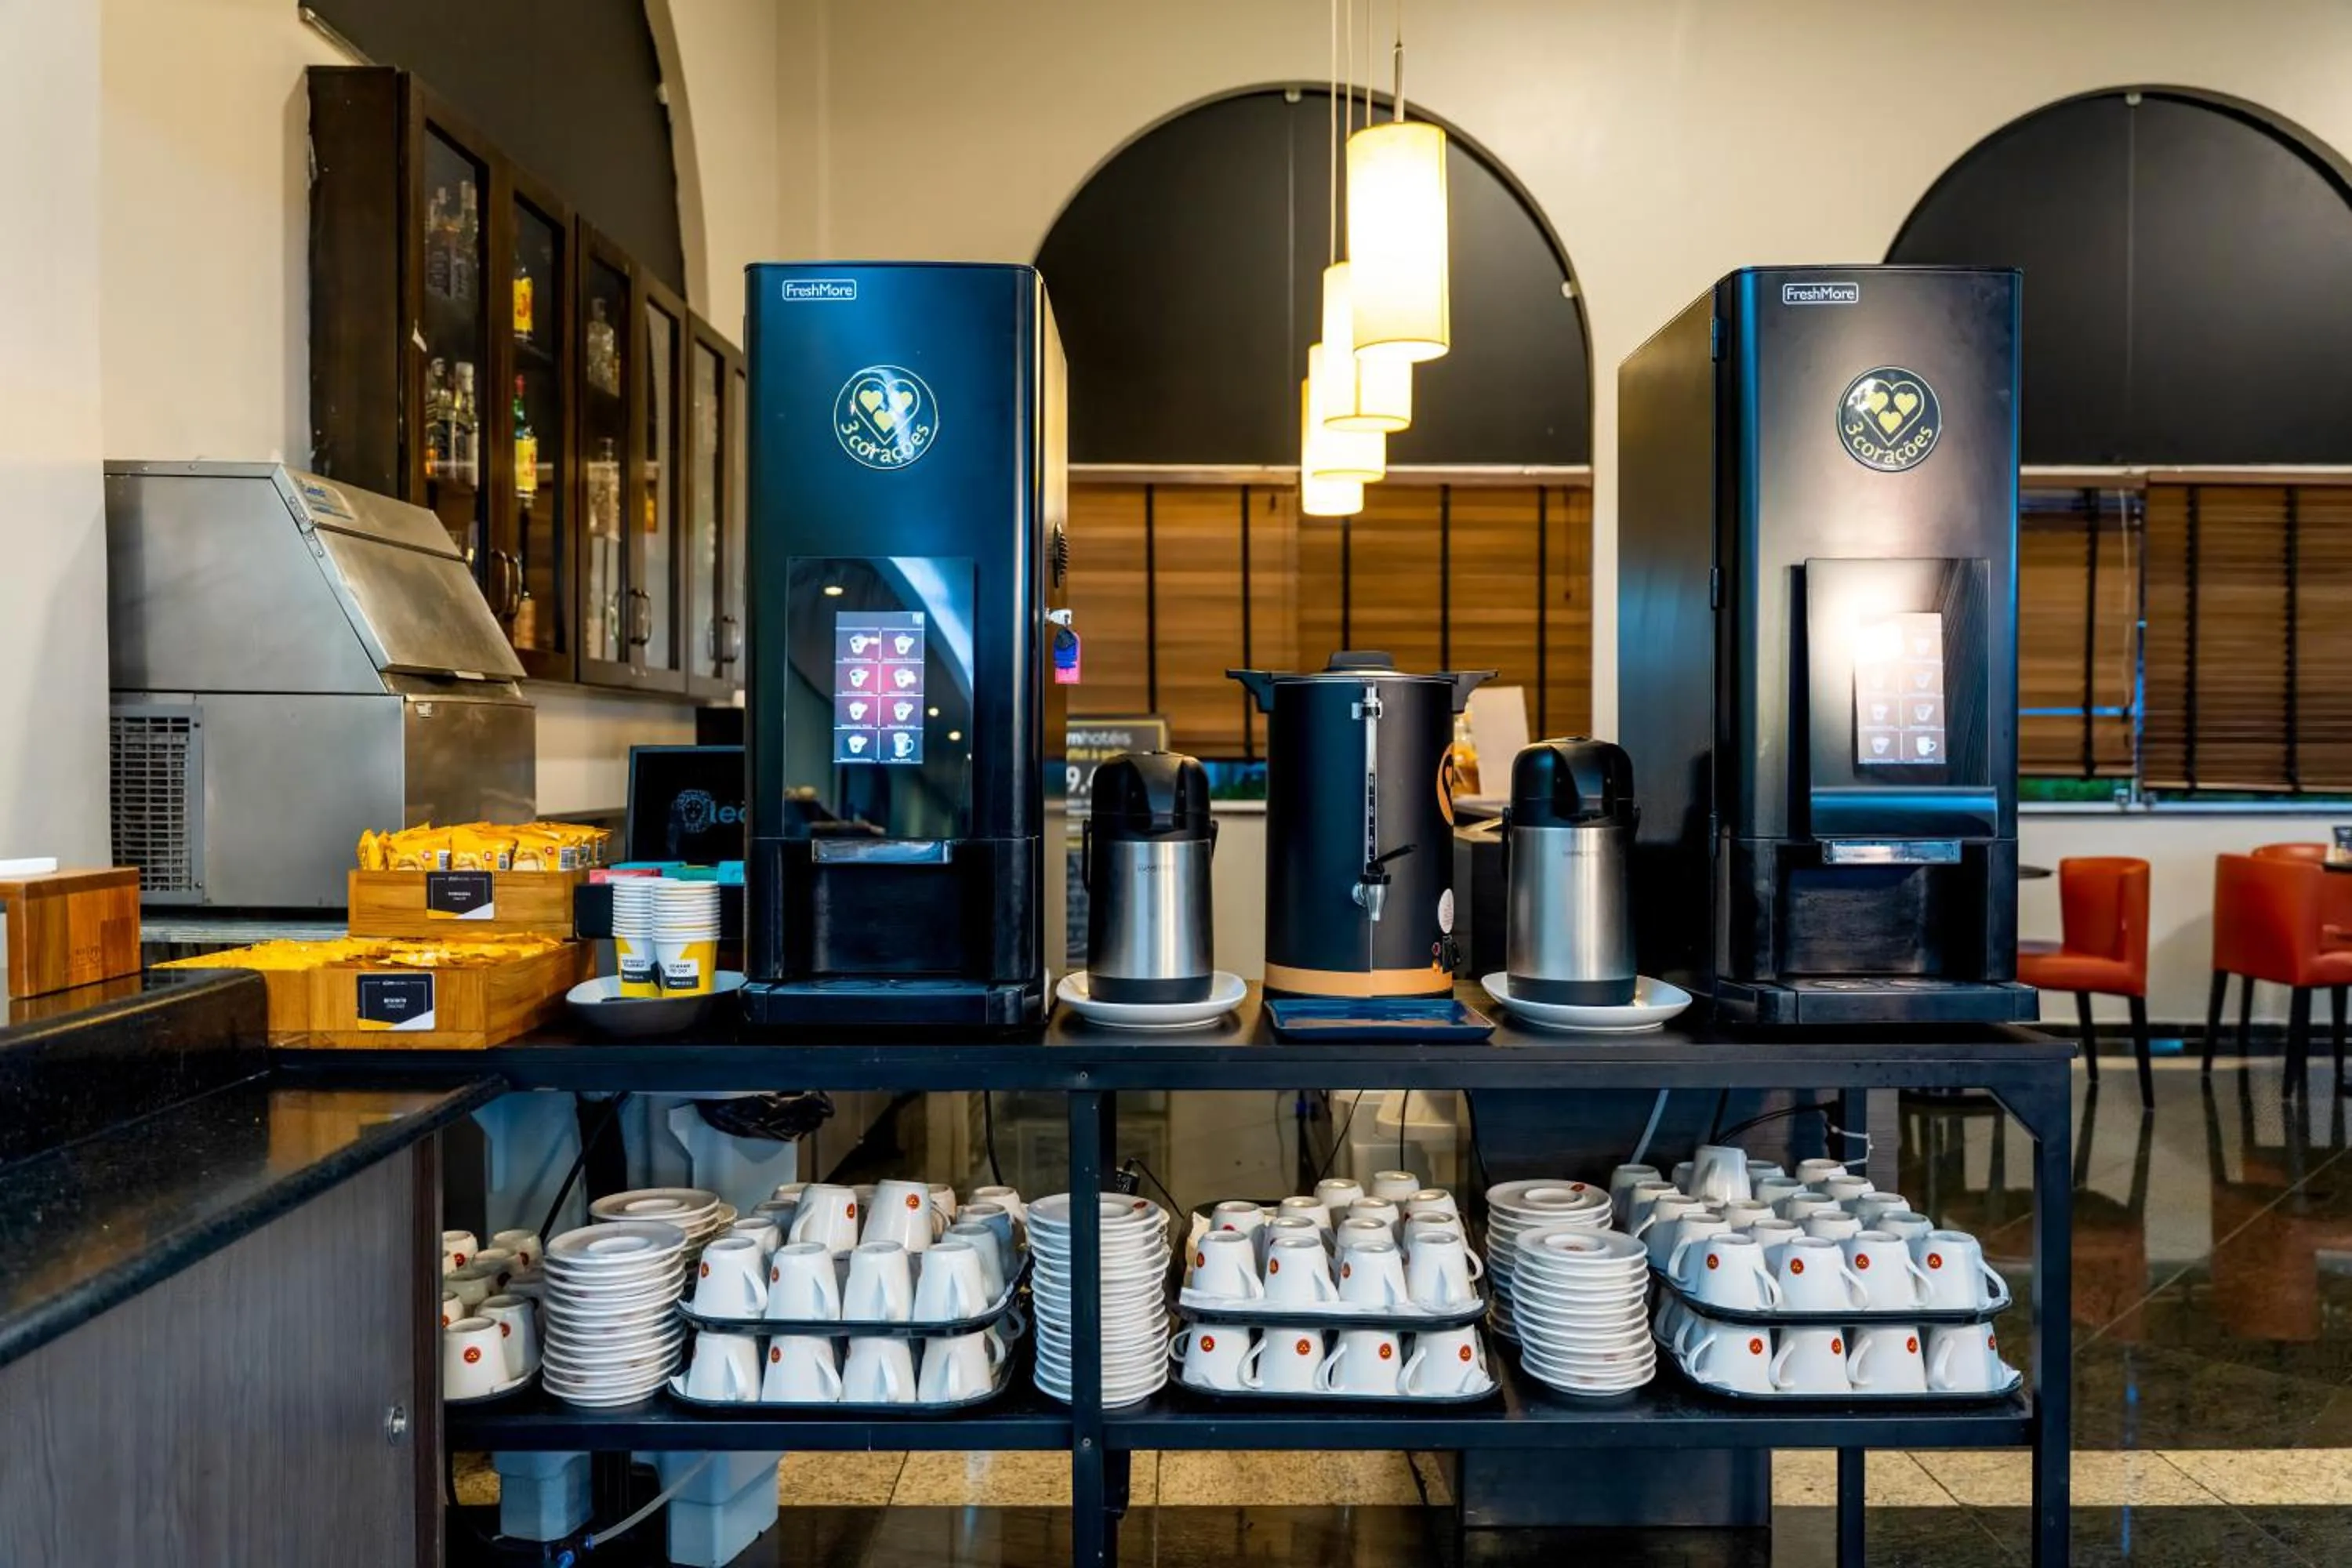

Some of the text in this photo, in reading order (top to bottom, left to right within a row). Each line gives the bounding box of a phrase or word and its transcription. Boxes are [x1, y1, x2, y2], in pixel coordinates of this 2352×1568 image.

[786, 283, 853, 297] FreshMore
[1786, 287, 1857, 300] FreshMore
[840, 419, 860, 434] 3
[1845, 421, 1933, 465] 3 corações
